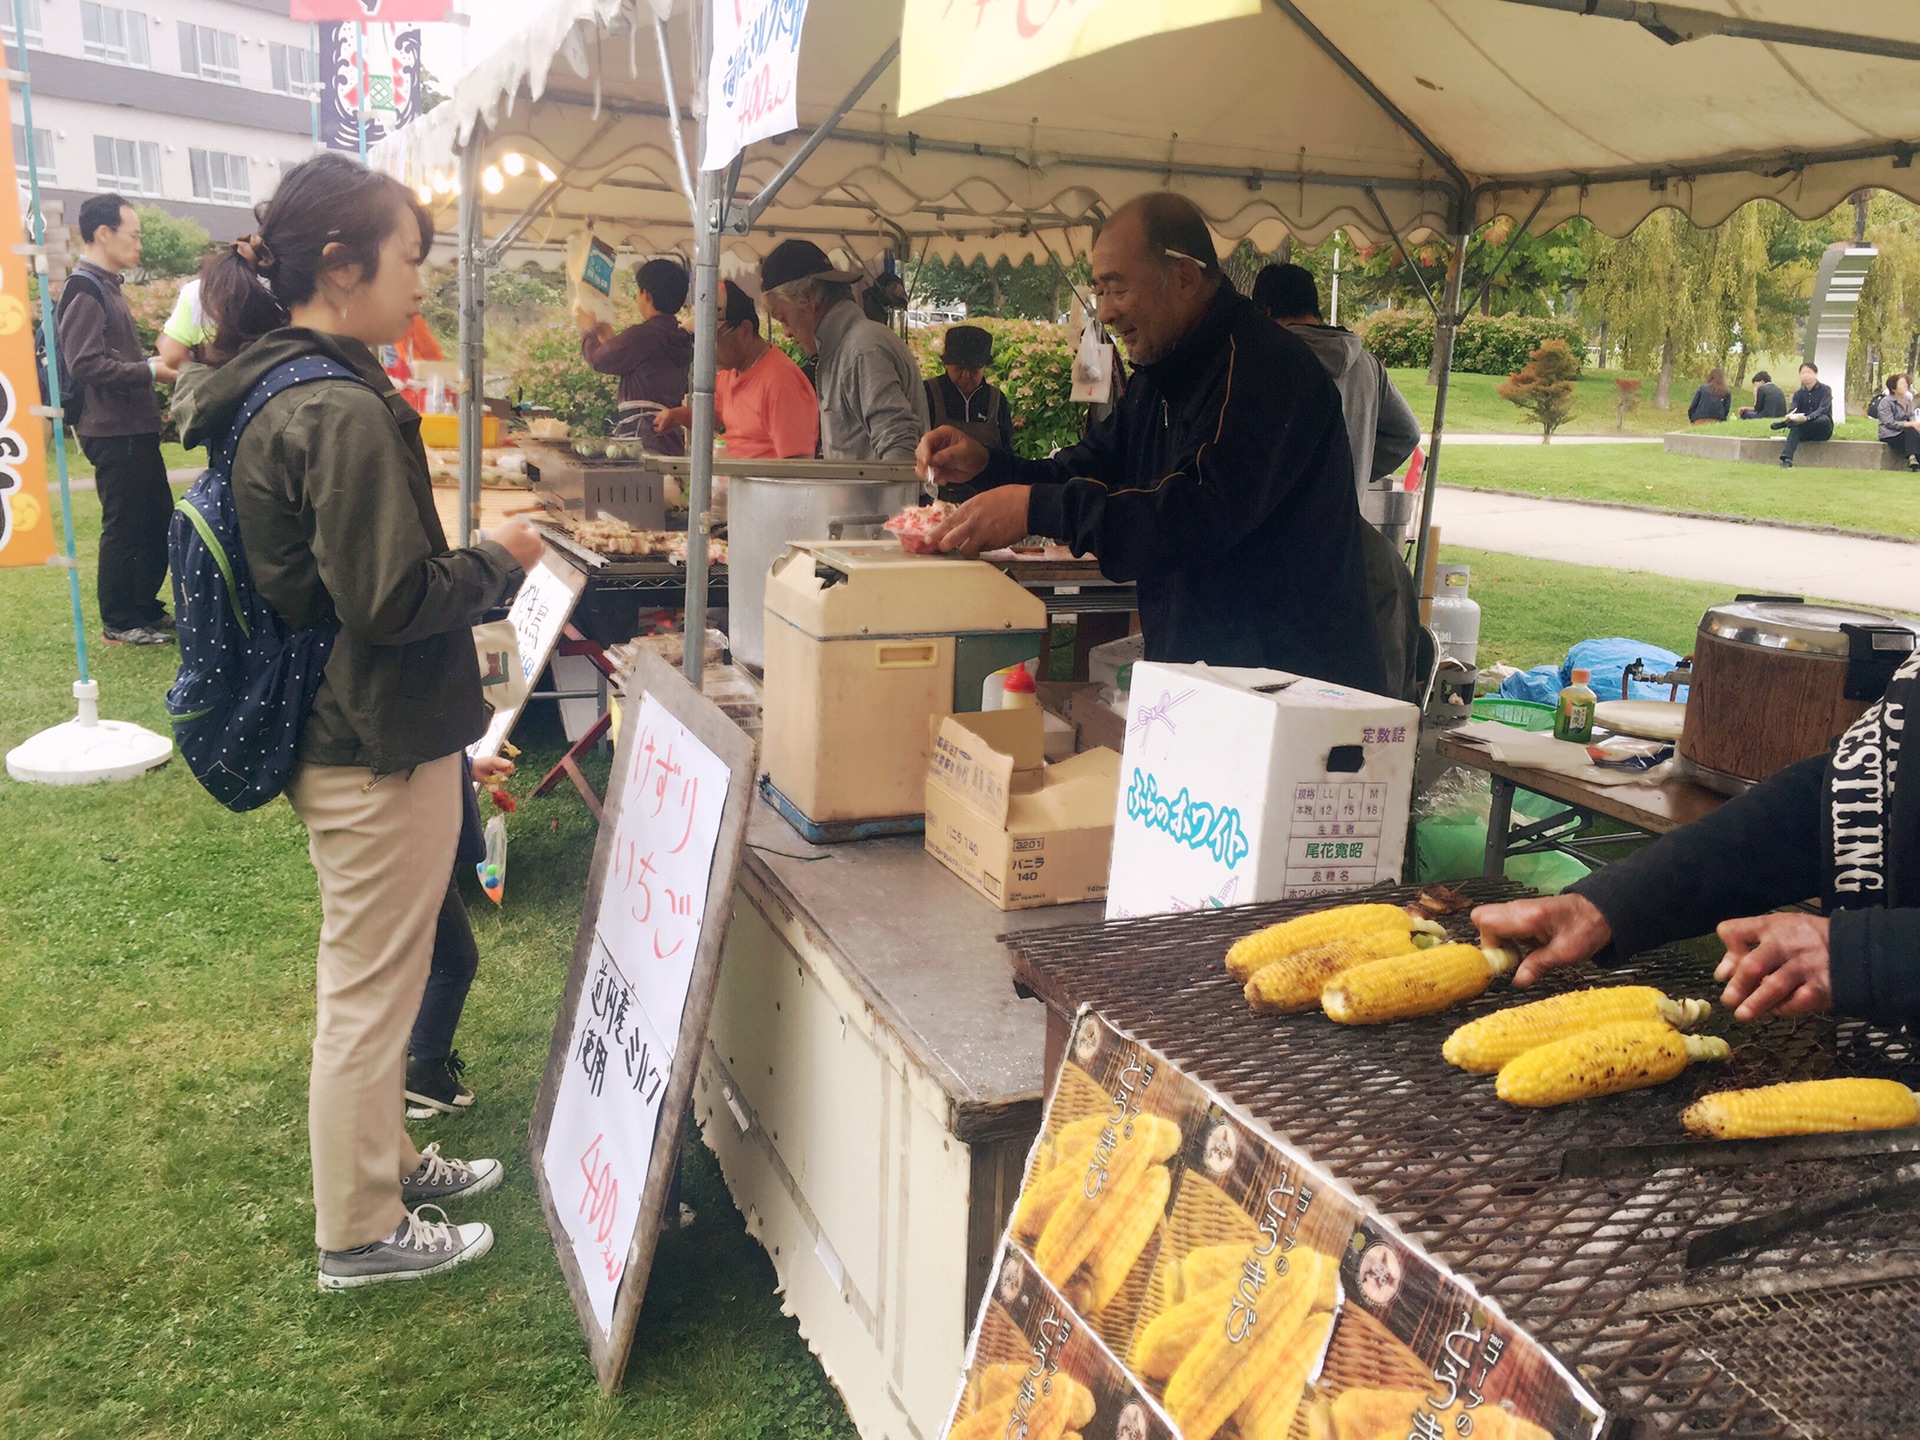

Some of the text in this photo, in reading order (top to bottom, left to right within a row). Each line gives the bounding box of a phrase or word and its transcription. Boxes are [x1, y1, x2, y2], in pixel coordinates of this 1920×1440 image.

[1362, 727, 1406, 744] 定数詰
[634, 734, 698, 854] けずり
[1296, 805, 1378, 815] 本数 12 15 18
[1297, 788, 1378, 800] 規格 LL L M
[1831, 696, 1885, 893] RESTLING
[1127, 767, 1249, 870] ふらのホワイト
[1318, 824, 1355, 835] 生産者
[1012, 857, 1045, 870] バニラ
[1015, 839, 1042, 850] 3201
[615, 836, 691, 960] いちご
[1017, 871, 1038, 882] 140
[1312, 870, 1350, 881] 品種名
[592, 960, 661, 1105] 道内産ミルク
[576, 1019, 608, 1096] 使用
[1084, 1053, 1142, 1199] とうきび
[1226, 1171, 1295, 1344] とうきび
